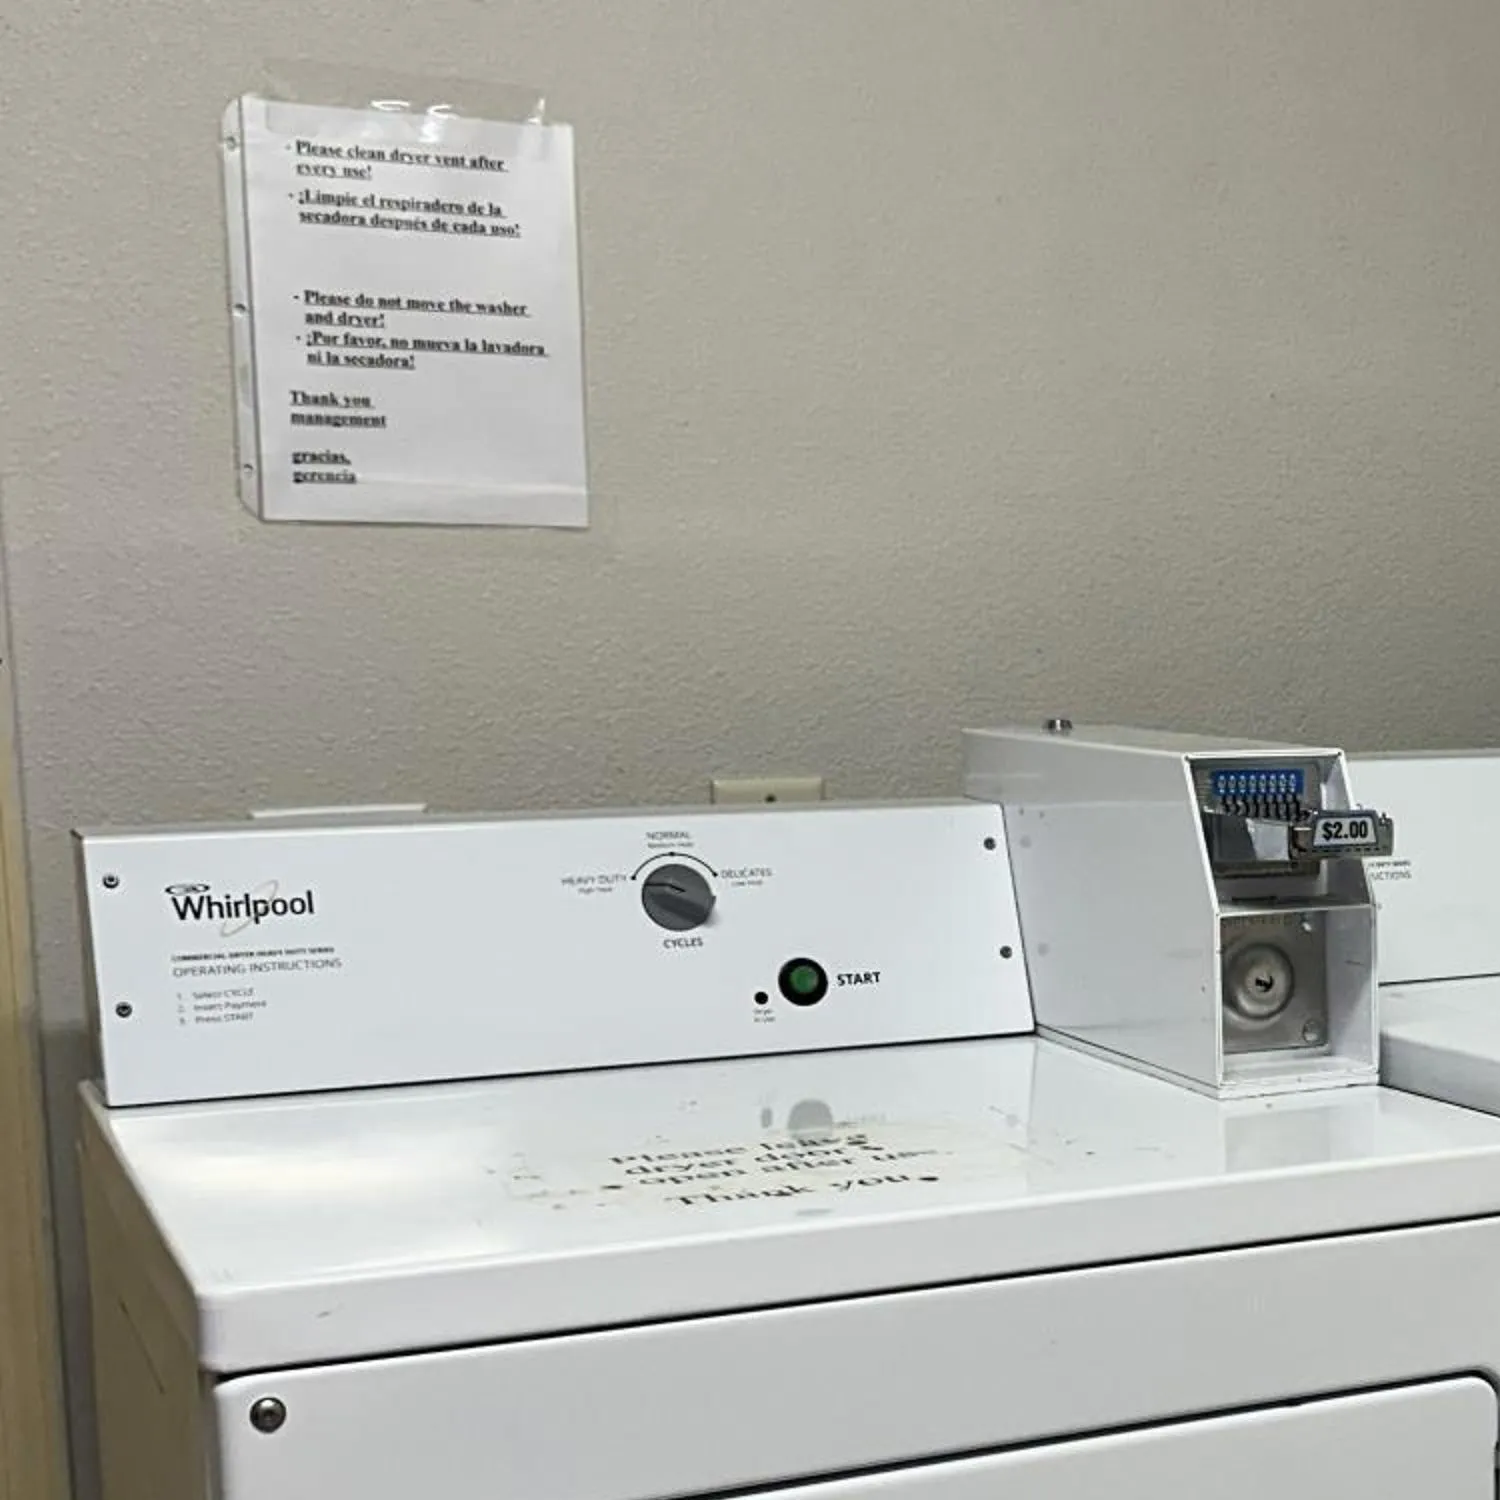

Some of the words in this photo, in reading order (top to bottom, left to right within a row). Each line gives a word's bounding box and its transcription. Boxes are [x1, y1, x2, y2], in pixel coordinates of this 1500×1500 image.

[1322, 820, 1368, 841] $2.00
[171, 889, 315, 924] Whirlpool
[663, 937, 703, 949] CYCLES
[172, 963, 246, 978] OPERATING
[249, 958, 342, 972] INSTRUCTIONS
[837, 971, 881, 986] START
[664, 1184, 815, 1206] Thank
